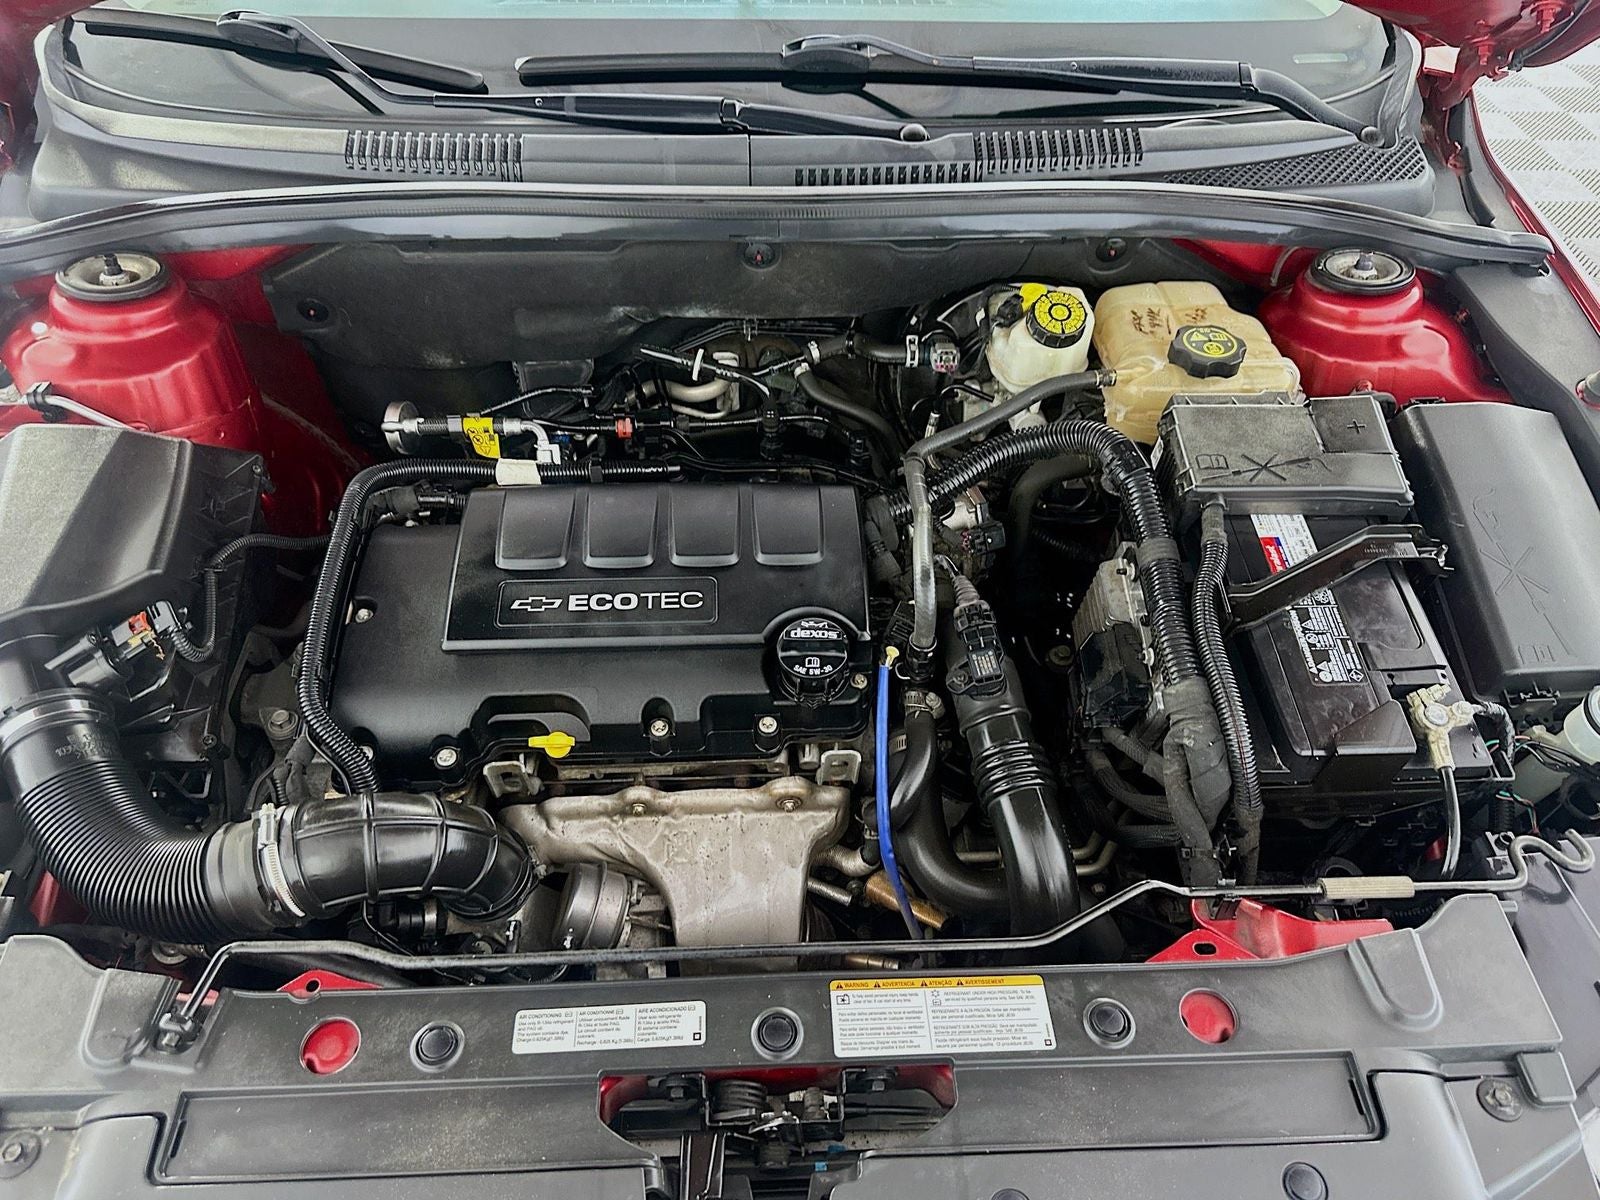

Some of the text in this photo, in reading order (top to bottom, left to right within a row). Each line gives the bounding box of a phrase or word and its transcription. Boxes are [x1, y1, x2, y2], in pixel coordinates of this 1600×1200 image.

[568, 591, 703, 611] ECOTEC
[790, 627, 839, 639] dexos
[793, 664, 833, 675] SAE 5W-30
